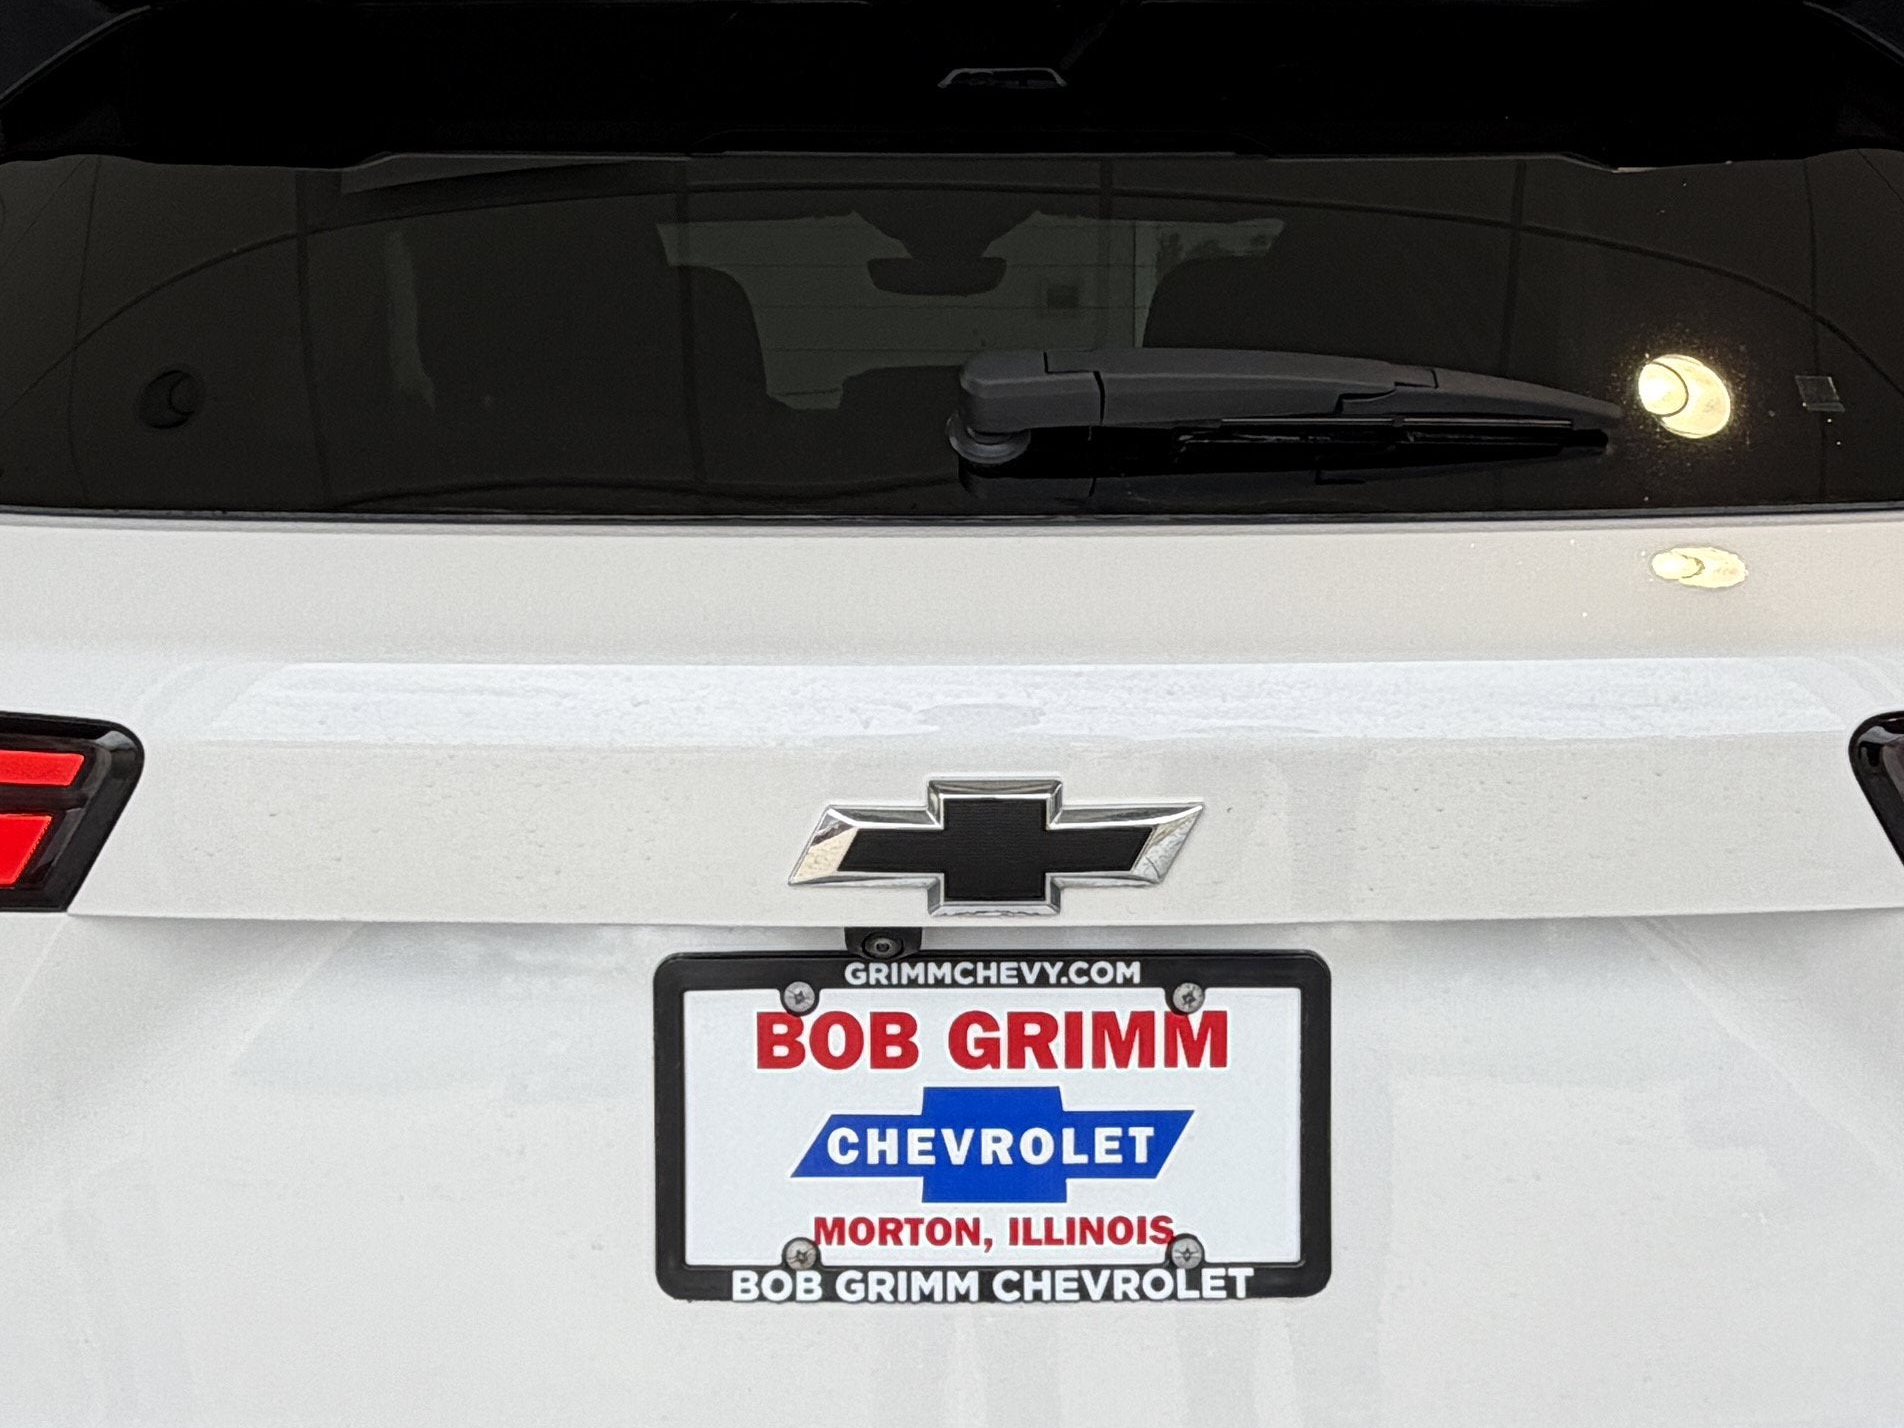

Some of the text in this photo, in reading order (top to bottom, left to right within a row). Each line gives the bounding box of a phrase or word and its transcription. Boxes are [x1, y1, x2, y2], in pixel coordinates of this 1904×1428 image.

[844, 961, 1142, 985] GRIMMCHEVY.COM
[756, 1010, 1228, 1070] BOB GRIMM
[827, 1127, 1155, 1166] CHEVROLET
[813, 1215, 1177, 1254] MORTON, ILLINOIS
[731, 1267, 1255, 1303] BOB GRIMM CHEVROLET
